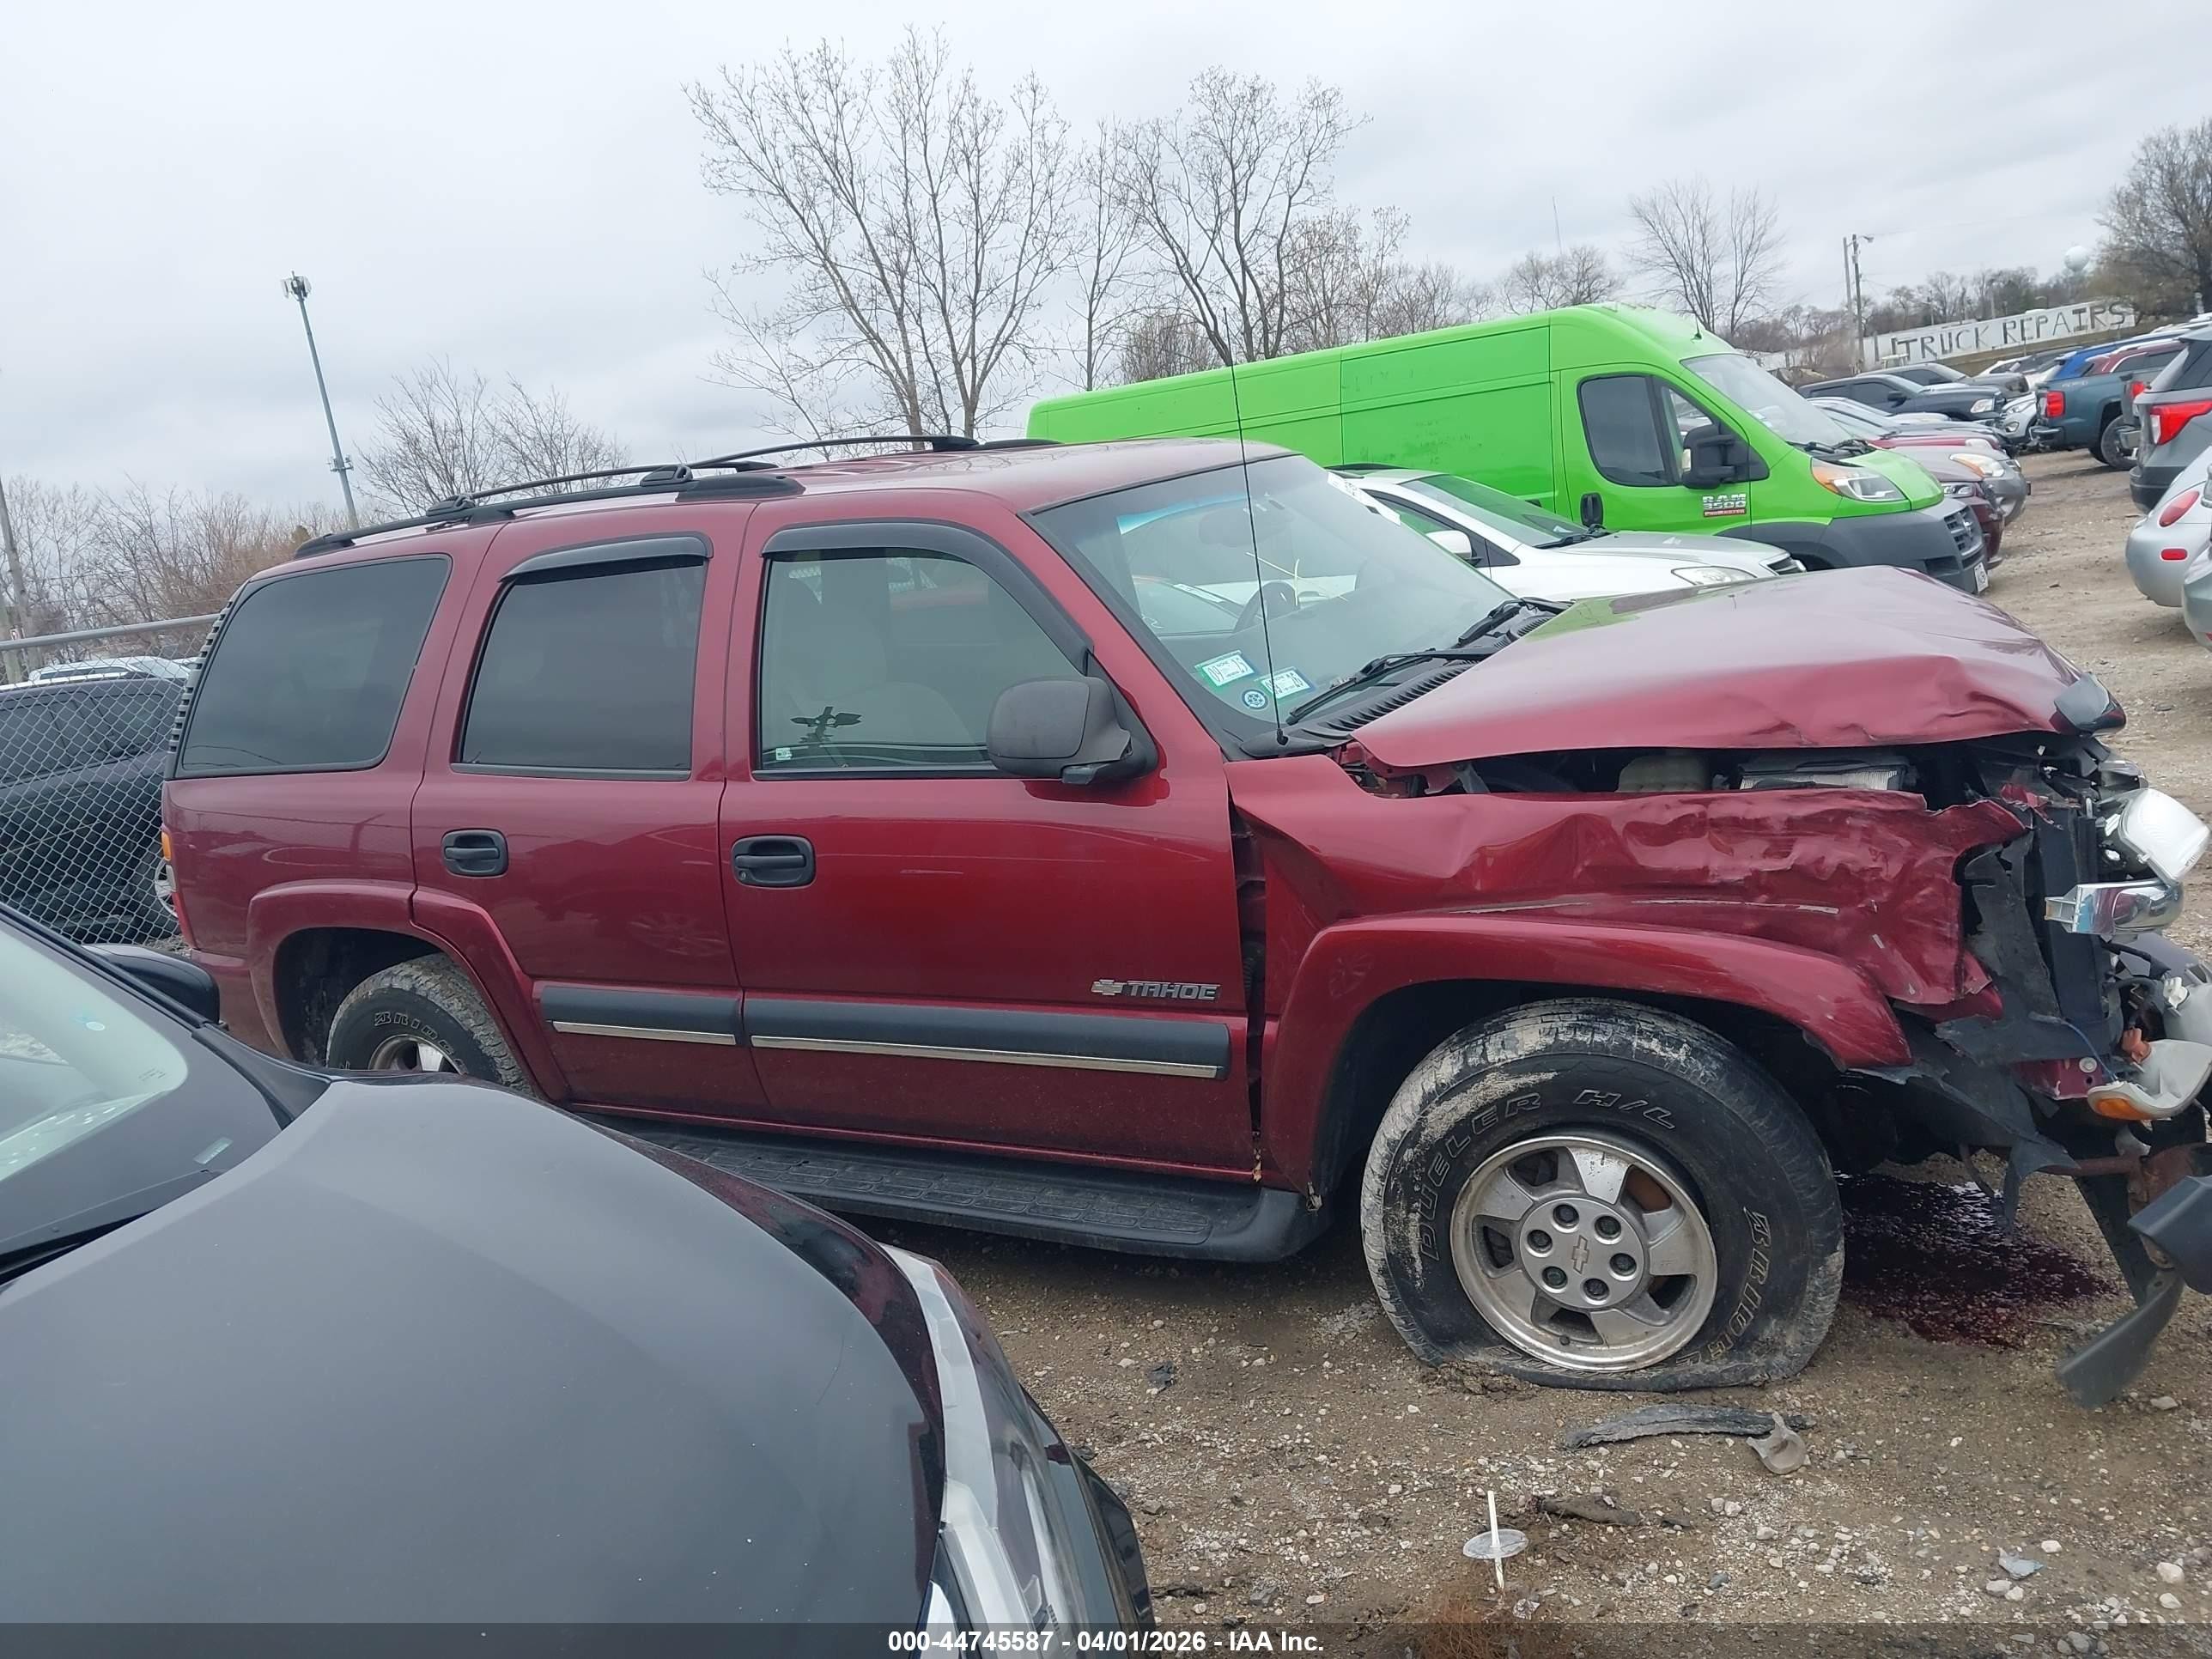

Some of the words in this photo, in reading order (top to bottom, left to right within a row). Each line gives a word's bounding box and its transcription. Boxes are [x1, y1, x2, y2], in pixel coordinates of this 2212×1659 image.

[1897, 325, 1990, 362] TRUCK
[2002, 301, 2126, 344] REPAIRS
[1702, 494, 1747, 503] RAM
[1127, 980, 1221, 1001] TAHOE
[1572, 1089, 1675, 1130] H/L
[1417, 1092, 1541, 1261] DUELER
